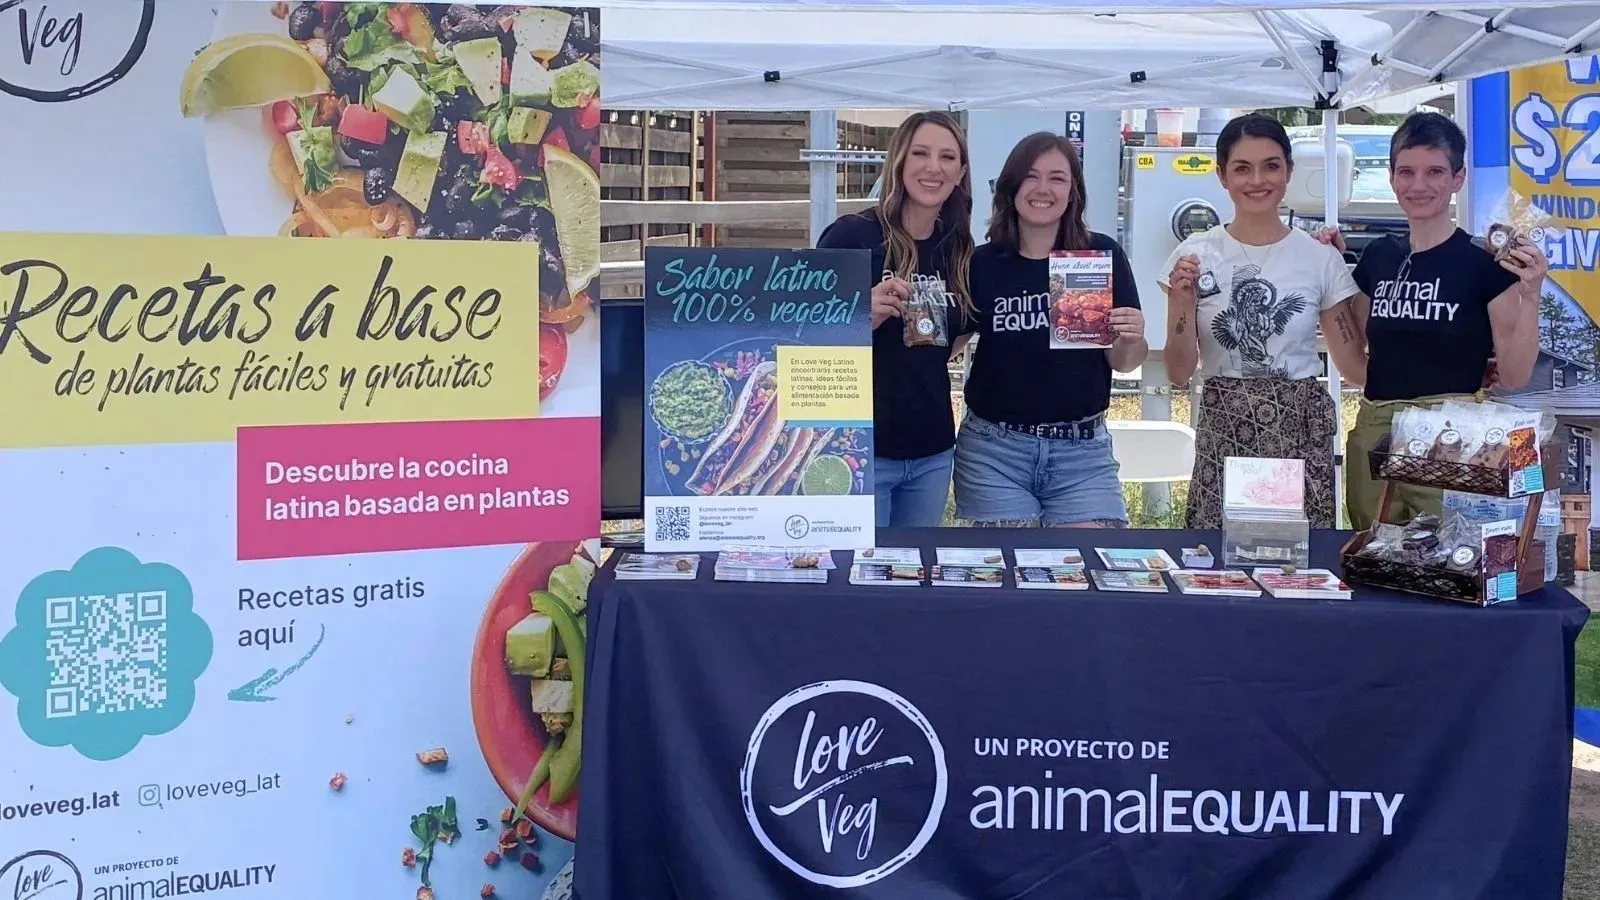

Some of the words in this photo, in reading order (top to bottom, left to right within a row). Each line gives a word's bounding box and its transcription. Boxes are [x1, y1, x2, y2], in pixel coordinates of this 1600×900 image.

[18, 6, 82, 75] Veg
[1138, 157, 1154, 166] CBA
[1531, 194, 1600, 220] WIND
[656, 254, 753, 297] Sabor
[763, 255, 838, 292] latino
[1374, 277, 1441, 302] animal
[0, 259, 275, 364] Recetas
[294, 284, 341, 342] a
[355, 255, 502, 342] base
[672, 292, 756, 324] 100%
[770, 290, 861, 338] vegetal
[993, 290, 1051, 314] anim
[1371, 298, 1460, 321] EQUALITY
[993, 311, 1050, 332] EQUA
[54, 350, 96, 397] de
[102, 354, 222, 412] plantas
[229, 350, 329, 401] fáciles
[338, 366, 354, 411] y
[364, 353, 494, 408] gratuitas
[266, 459, 394, 484] Descubre
[399, 457, 420, 479] la
[425, 454, 508, 478] cocina
[265, 495, 340, 520] latina
[345, 491, 440, 517] basada
[444, 493, 475, 512] en
[479, 487, 570, 515] plantas
[238, 585, 345, 611] Recetas
[353, 576, 425, 608] gratis
[238, 619, 296, 651] aquí
[974, 737, 1009, 757] UN
[1016, 738, 1134, 760] PROYECTO
[1141, 740, 1170, 760] DE
[167, 773, 281, 800] loveveg_lat
[0, 790, 120, 821] oveveg.lat
[969, 770, 1405, 836] animalEQUALITY
[816, 796, 878, 861] Veg
[94, 866, 110, 875] UN
[112, 858, 164, 873] PROYECTO
[166, 856, 179, 866] DE
[93, 864, 277, 900] animalEQUALITY
